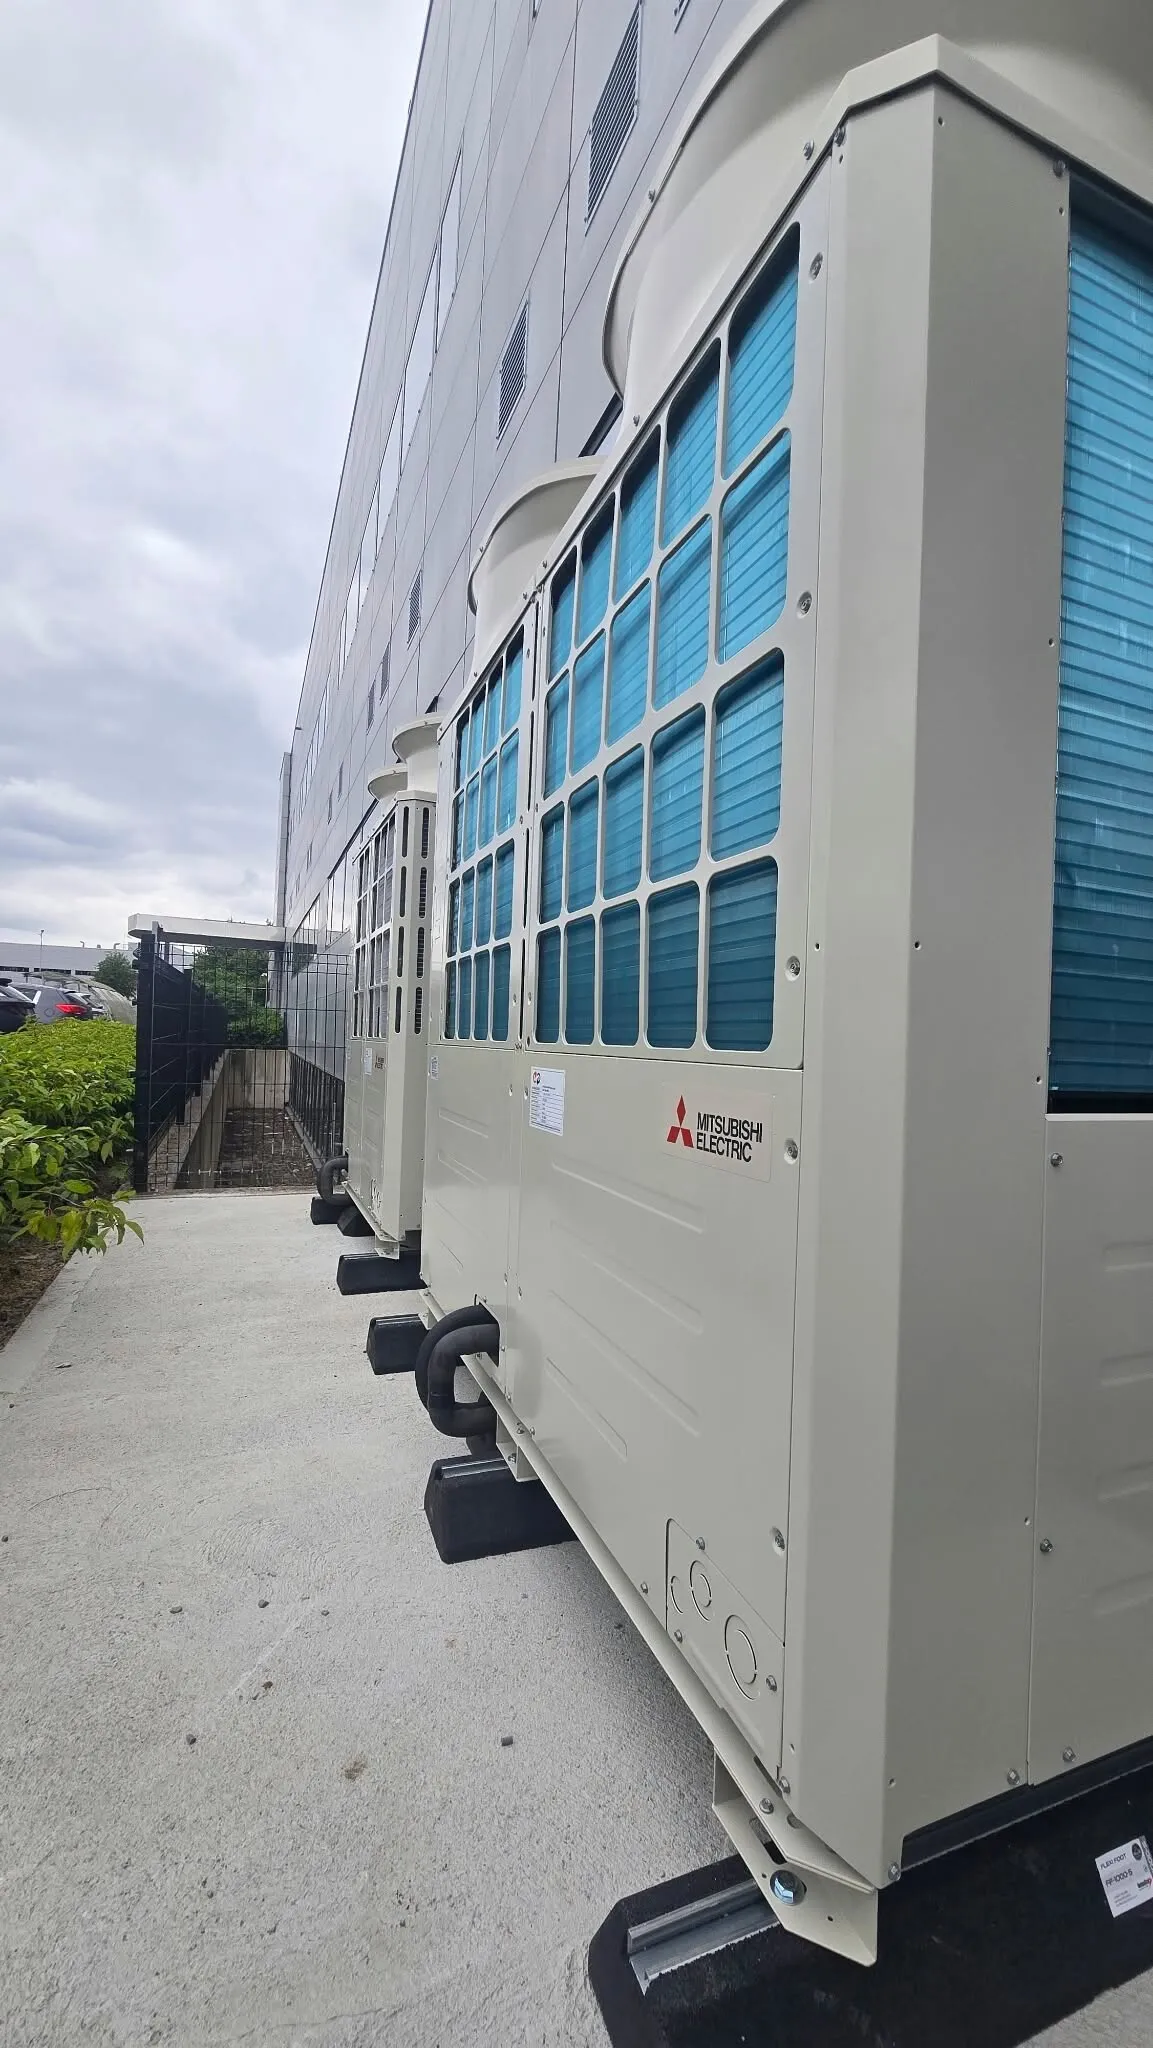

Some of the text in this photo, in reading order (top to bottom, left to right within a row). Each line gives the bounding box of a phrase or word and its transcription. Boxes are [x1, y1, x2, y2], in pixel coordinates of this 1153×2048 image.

[697, 1112, 762, 1143] MITSUBISHI
[696, 1132, 752, 1162] ELECTRIC
[1113, 1853, 1127, 1863] FOOT
